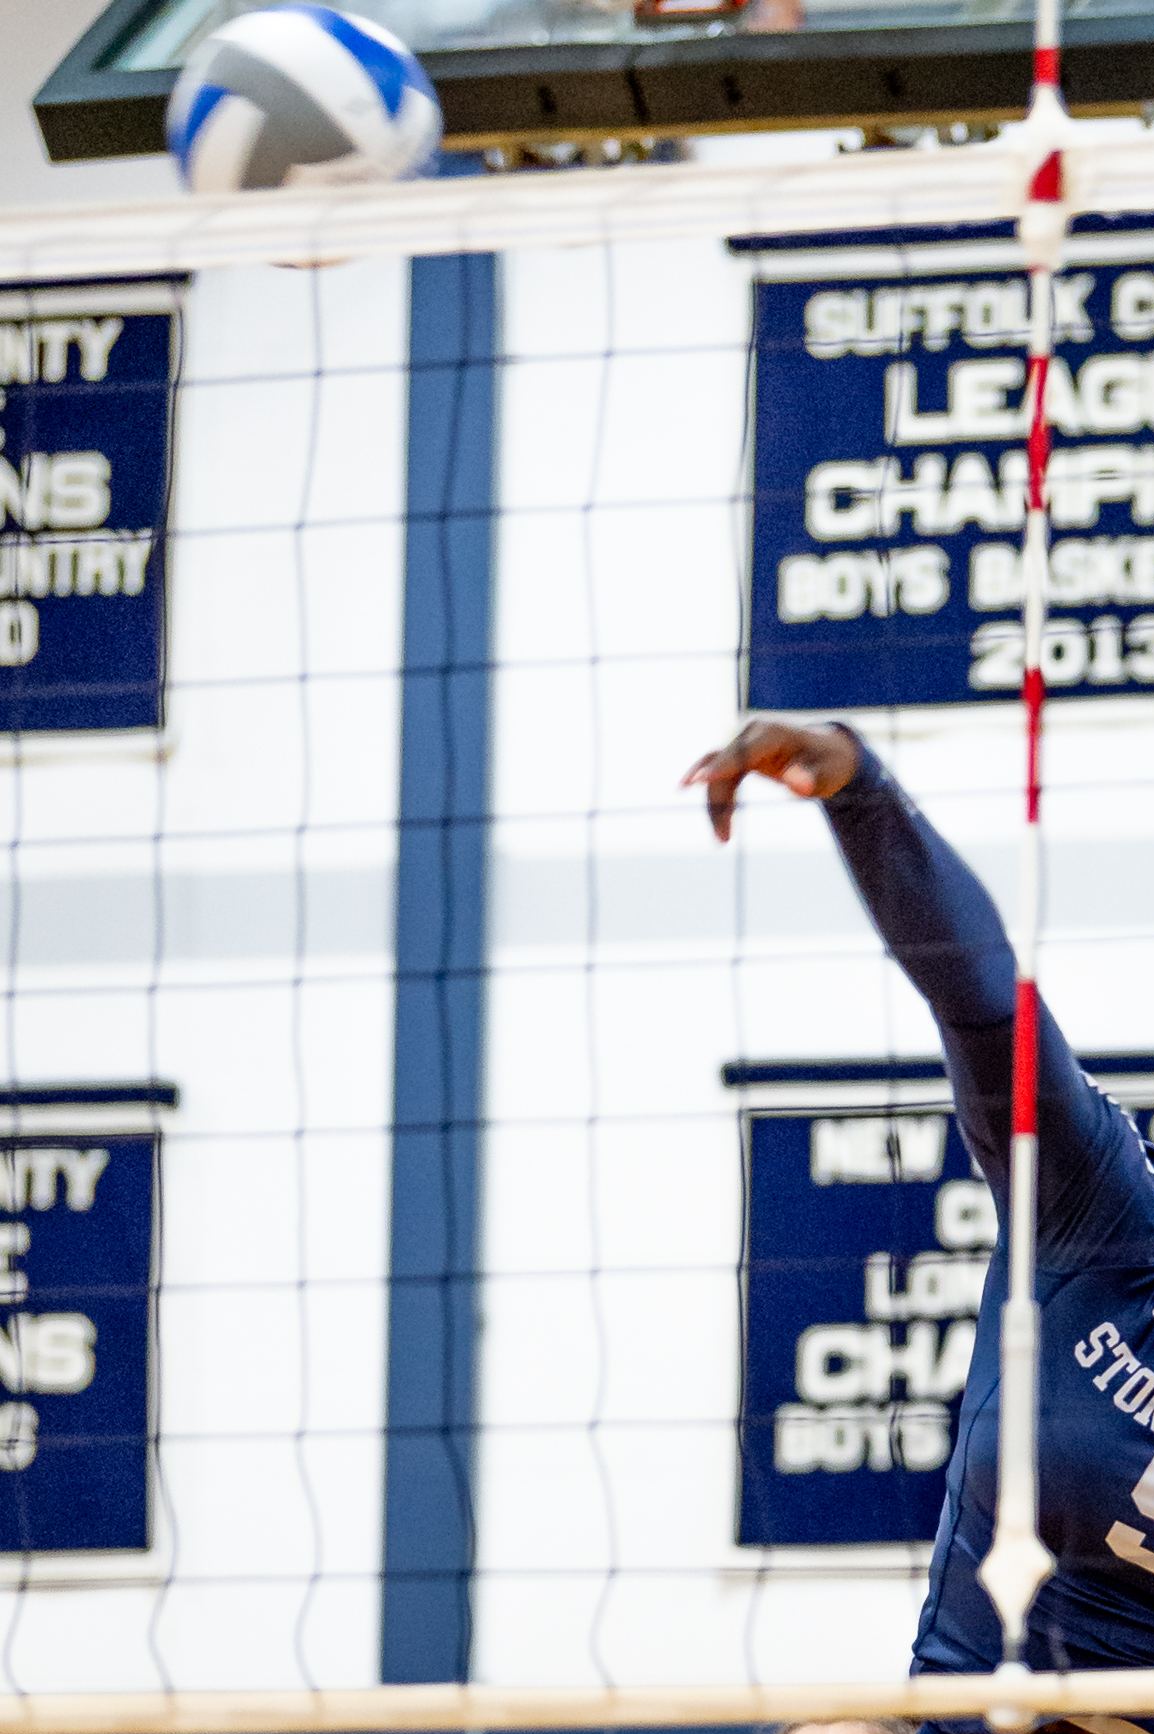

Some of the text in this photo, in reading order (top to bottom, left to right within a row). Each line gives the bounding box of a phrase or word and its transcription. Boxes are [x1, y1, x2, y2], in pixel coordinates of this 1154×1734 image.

[805, 272, 1095, 357] SUFFOLK
[778, 547, 951, 622] BOYS
[811, 1114, 946, 1185] NEW
[775, 1401, 952, 1474] BOYS
